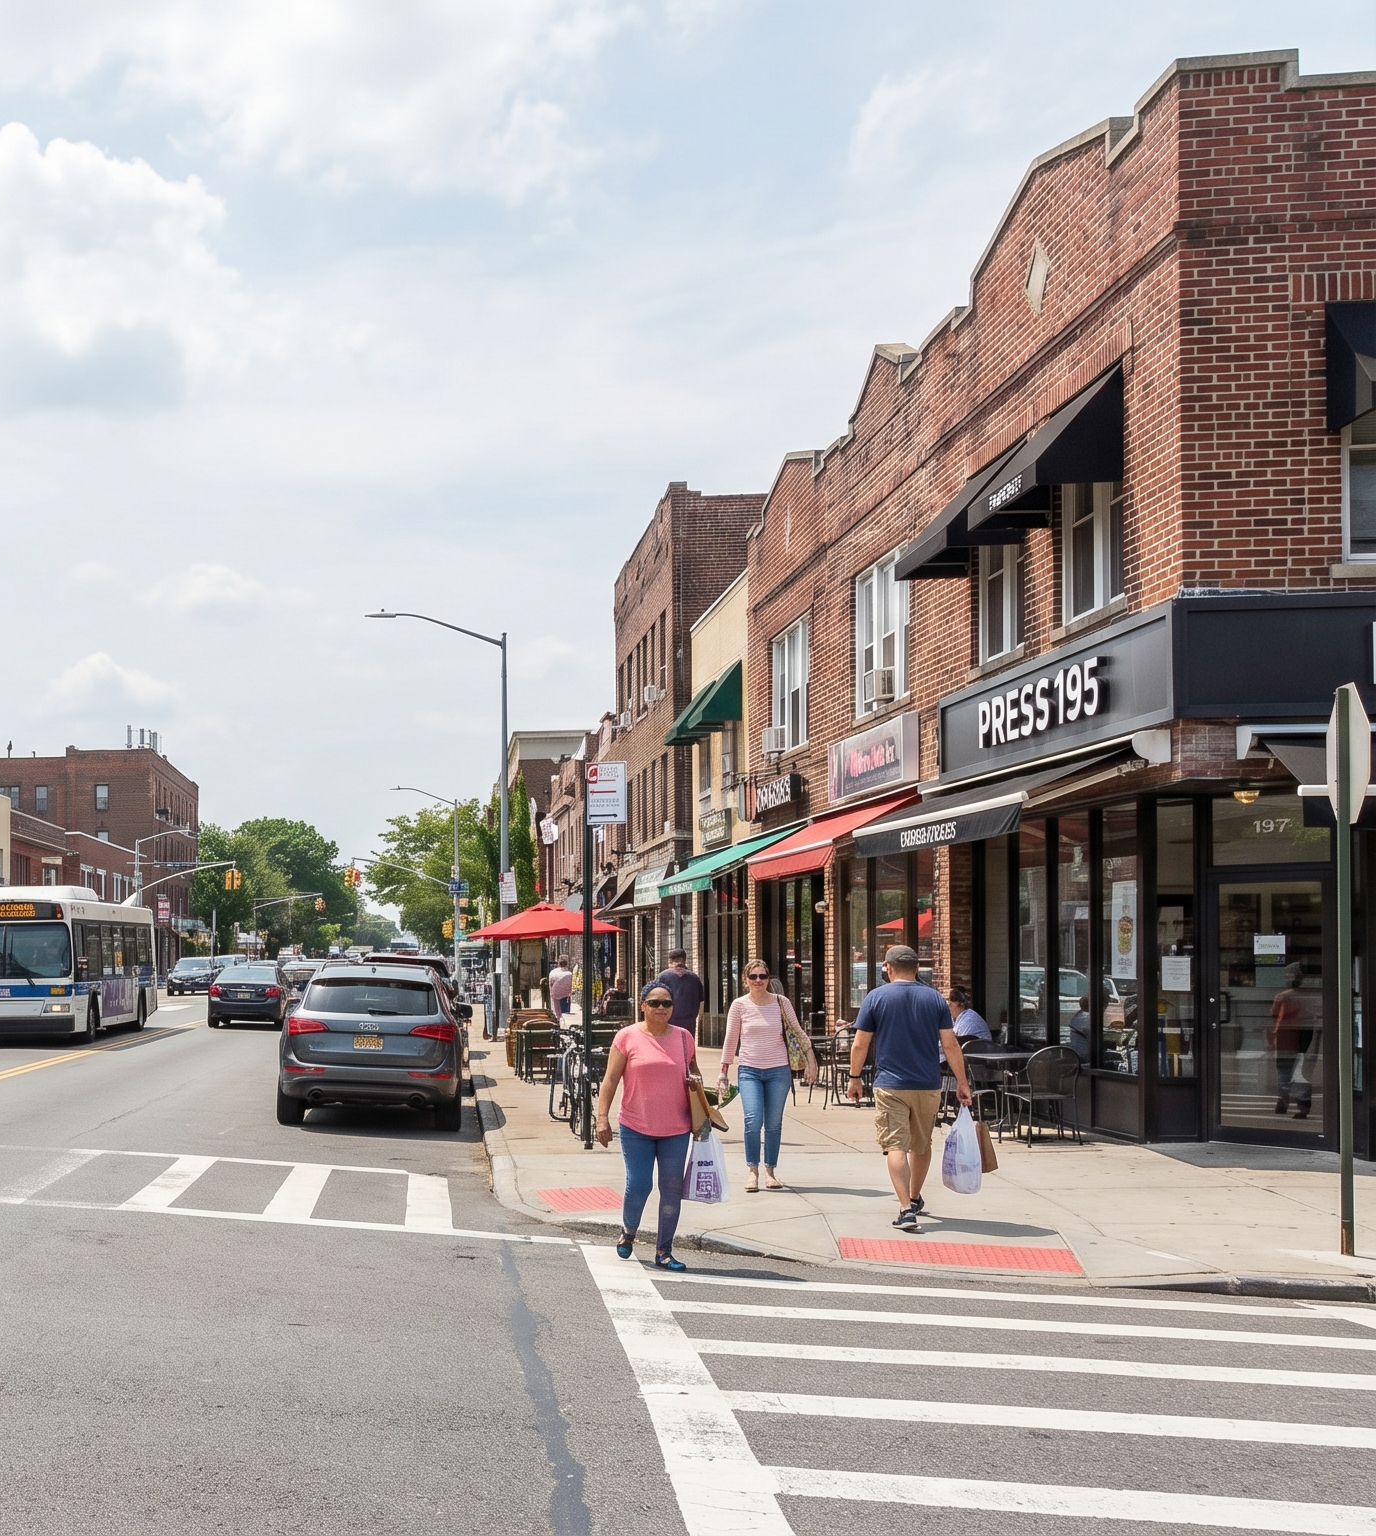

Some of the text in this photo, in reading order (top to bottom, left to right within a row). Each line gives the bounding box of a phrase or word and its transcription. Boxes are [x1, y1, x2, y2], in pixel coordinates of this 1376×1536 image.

[978, 656, 1099, 749] PRESS 195
[1253, 818, 1291, 834] 197
